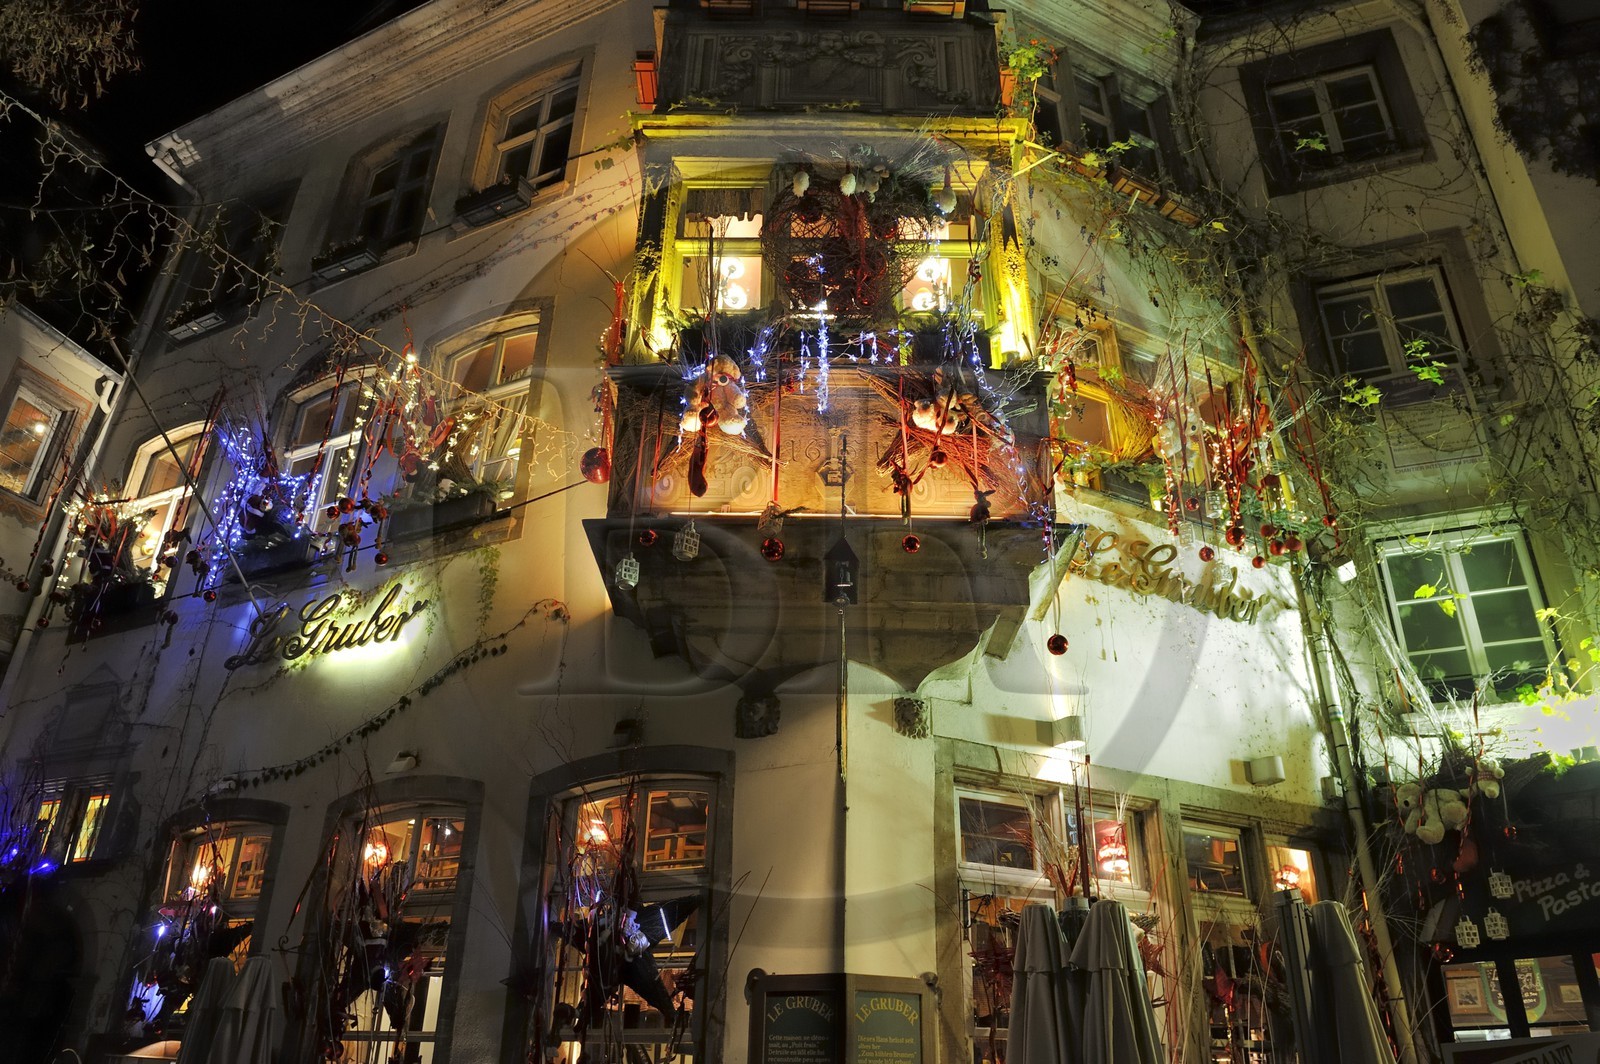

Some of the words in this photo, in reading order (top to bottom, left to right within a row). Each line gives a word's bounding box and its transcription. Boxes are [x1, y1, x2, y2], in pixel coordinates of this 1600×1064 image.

[223, 602, 290, 670] Le
[282, 583, 429, 661] Gruber
[1513, 872, 1570, 903] Pizza
[1574, 862, 1590, 880] &
[767, 1003, 784, 1023] LE
[785, 995, 835, 1024] GRUBER
[855, 1004, 871, 1024] LE
[870, 997, 919, 1027] GRUBER
